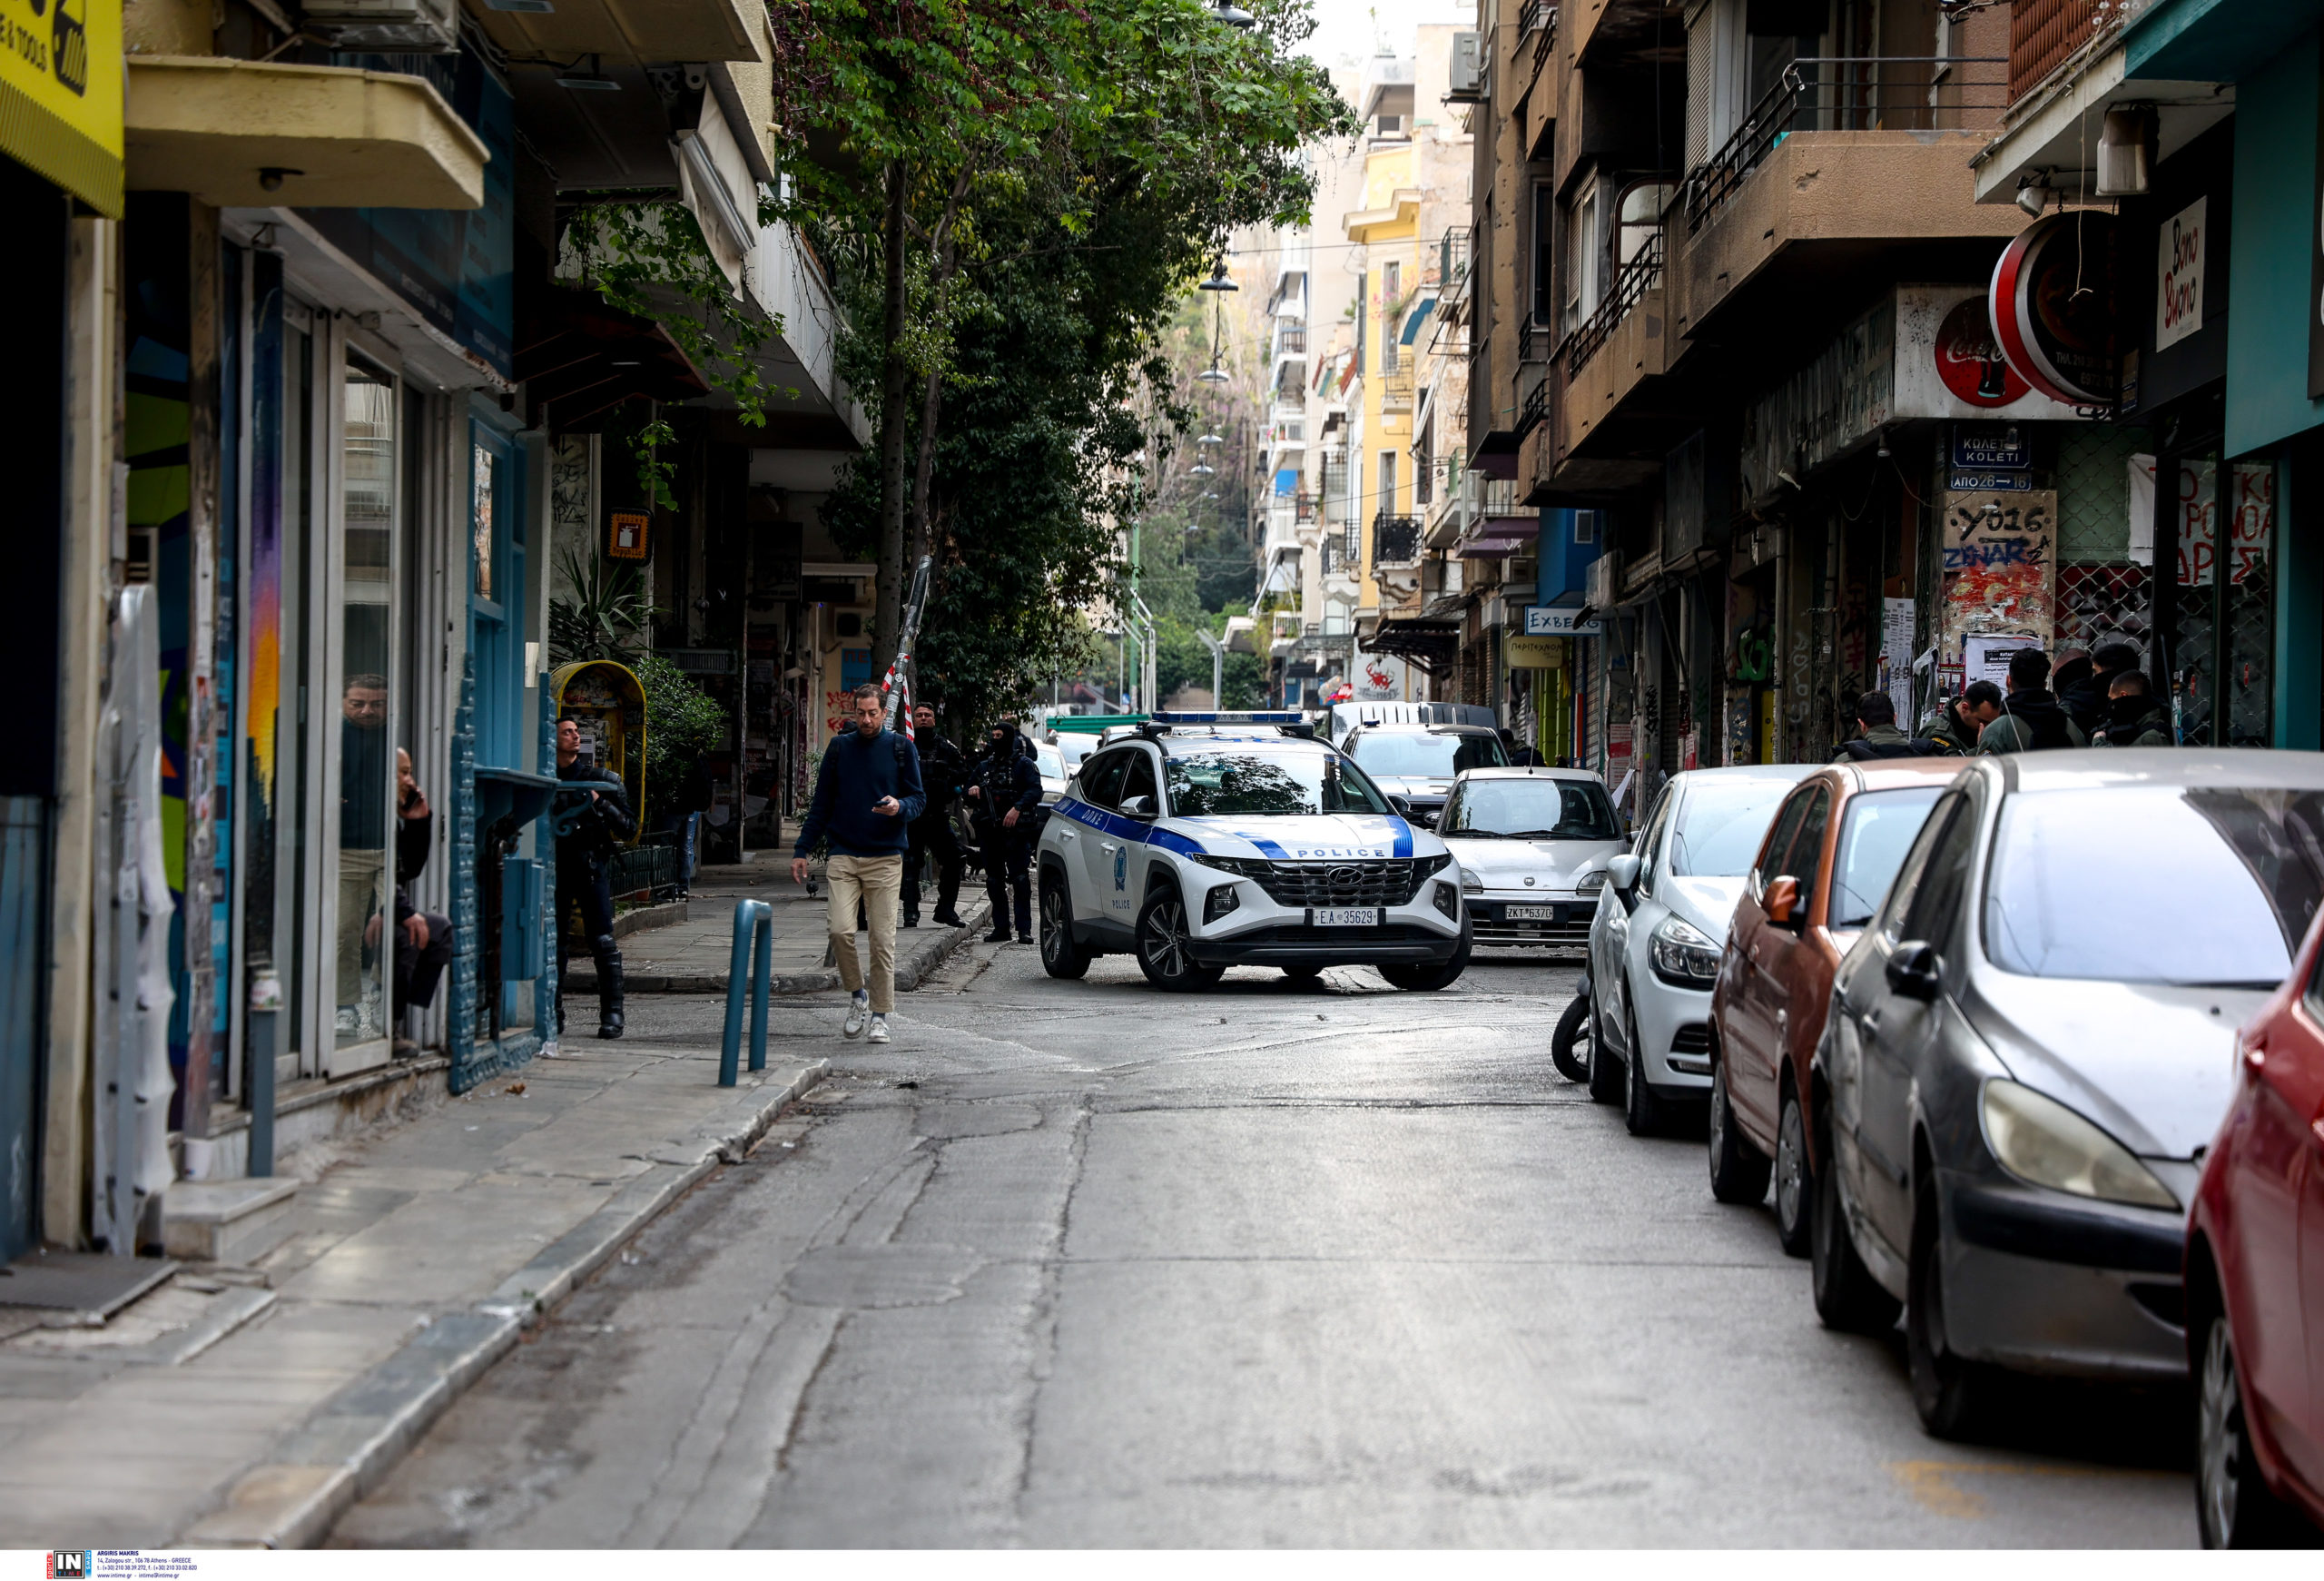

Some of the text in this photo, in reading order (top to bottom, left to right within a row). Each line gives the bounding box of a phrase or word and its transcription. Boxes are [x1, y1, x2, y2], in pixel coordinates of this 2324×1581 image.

[17, 25, 46, 73] TOOLS
[2172, 219, 2198, 276] Bono
[2165, 272, 2196, 329] Buono
[1966, 452, 2018, 461] KOLETI
[1954, 476, 2025, 488] ΑΠΟ 26 16
[1530, 613, 1600, 628] EXBEG
[1297, 849, 1385, 858] POLICE
[1112, 899, 1130, 910] POLICE
[1344, 911, 1373, 924] 35629
[1507, 908, 1551, 918] ZKT 6370
